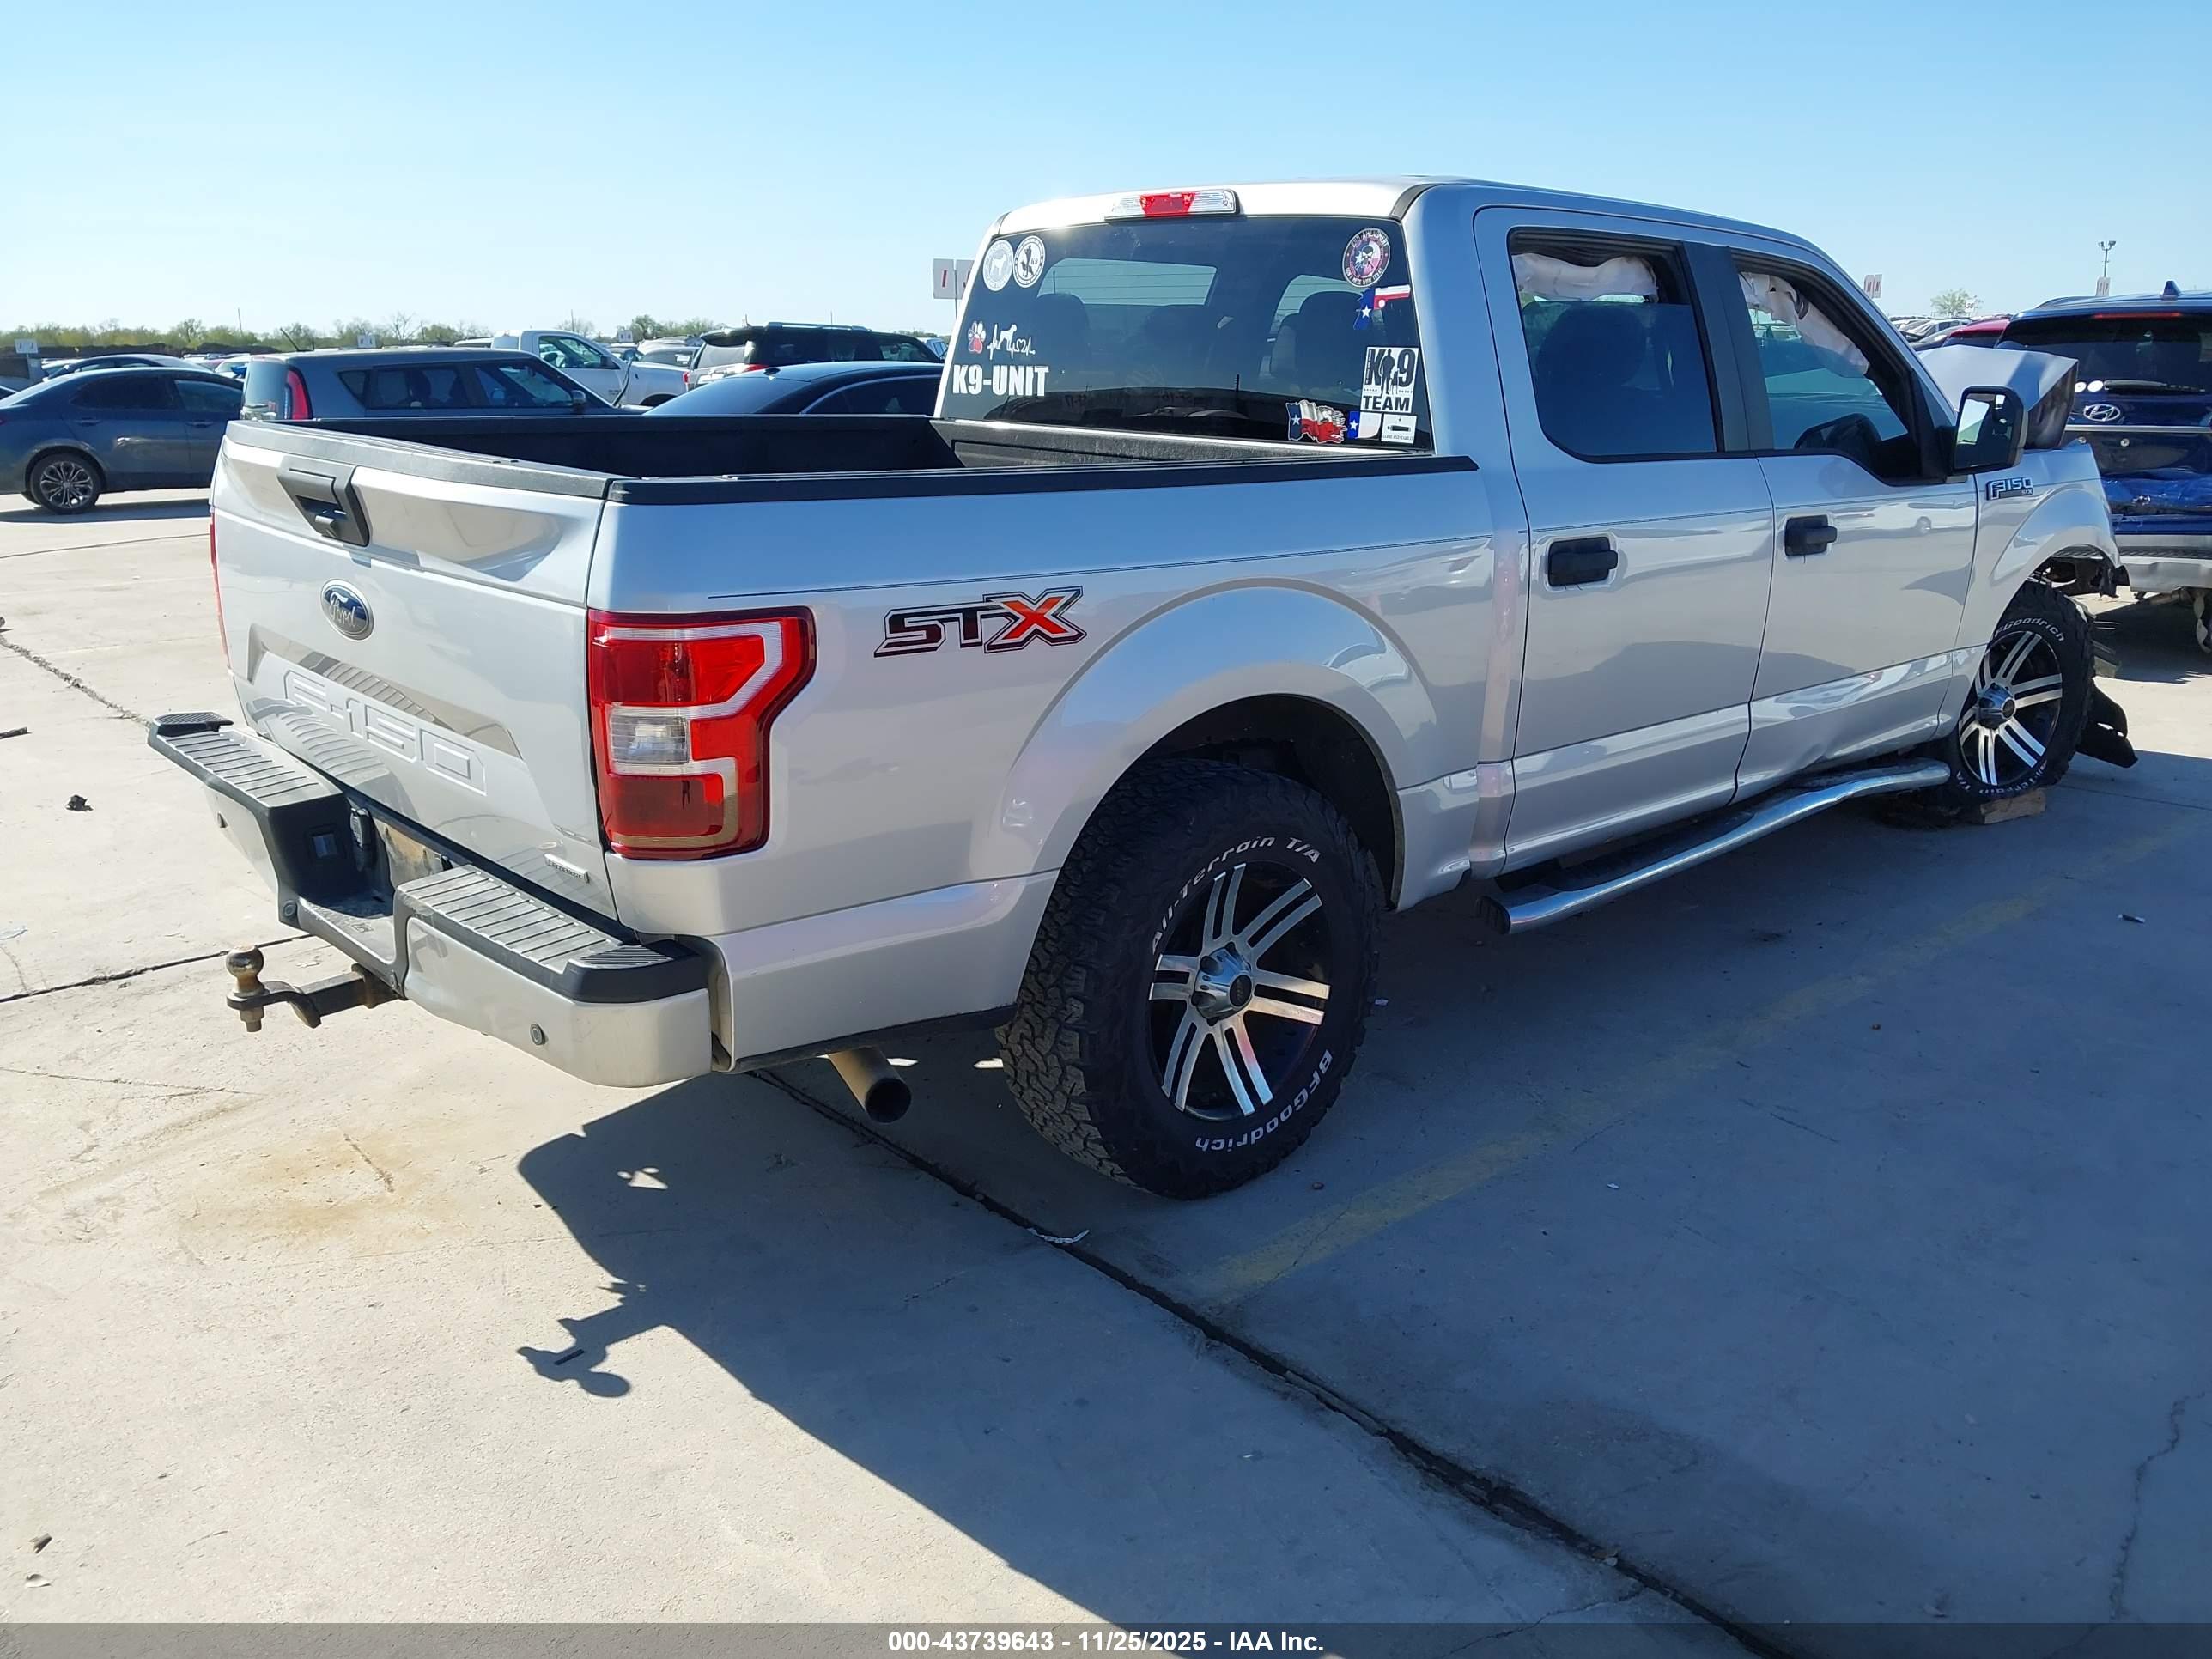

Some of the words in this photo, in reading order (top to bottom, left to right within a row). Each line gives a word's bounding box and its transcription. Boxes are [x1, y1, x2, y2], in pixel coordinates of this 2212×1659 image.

[952, 364, 1049, 397] K9-UNIT
[1363, 395, 1411, 412] TEAM
[330, 592, 357, 628] Ford
[873, 586, 1088, 658] STX
[283, 669, 487, 797] F-150
[1152, 836, 1276, 956] All-Terrain
[1286, 836, 1322, 864] T/A
[1194, 1048, 1334, 1152] BFGoodrich
